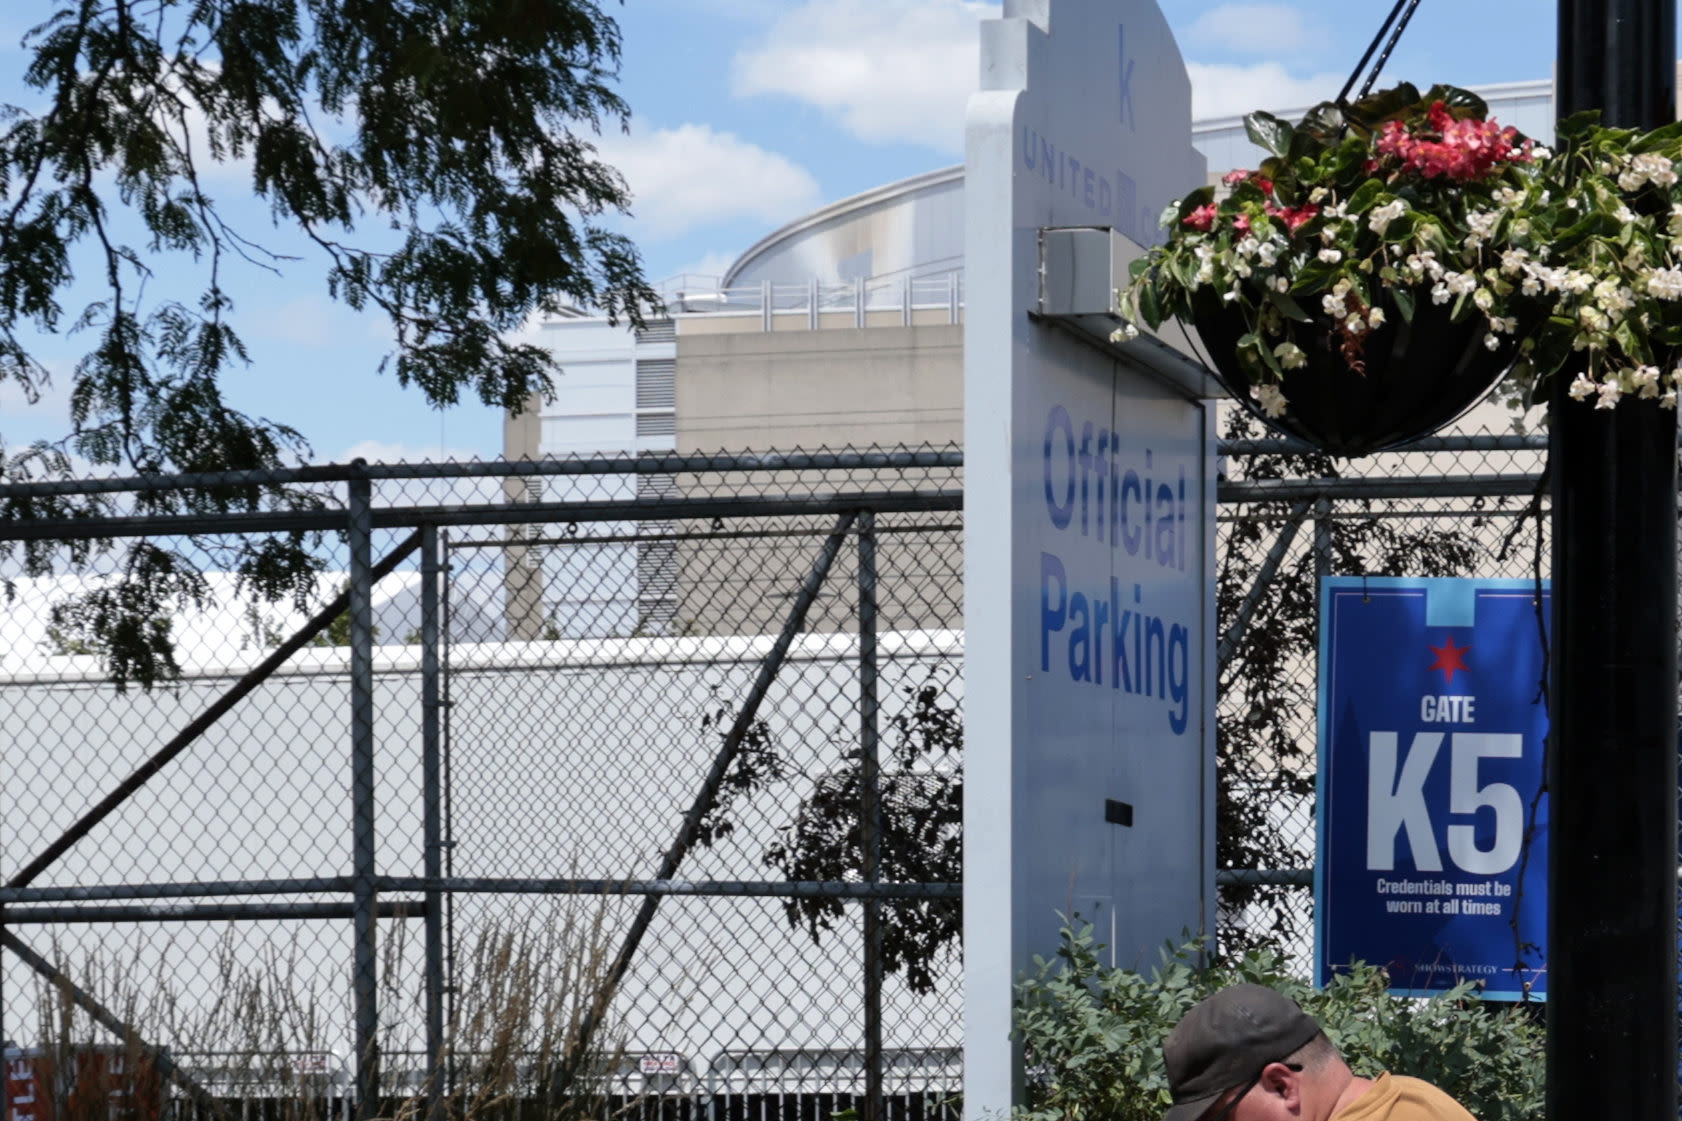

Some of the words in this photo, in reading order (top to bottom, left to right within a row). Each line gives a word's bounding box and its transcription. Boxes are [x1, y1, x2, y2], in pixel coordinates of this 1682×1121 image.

[1023, 126, 1112, 217] UNITED
[1043, 404, 1186, 572] Official
[1041, 551, 1189, 736] Parking
[1420, 695, 1476, 723] GATE
[1366, 731, 1524, 875] K5
[1376, 878, 1453, 896] Credentials
[1456, 880, 1492, 896] must
[1495, 881, 1511, 896] be
[1386, 900, 1423, 913] worn
[1425, 899, 1440, 914] at
[1442, 899, 1459, 914] all
[1462, 899, 1501, 915] times
[1414, 963, 1498, 974] SHOWSTRATEGY
